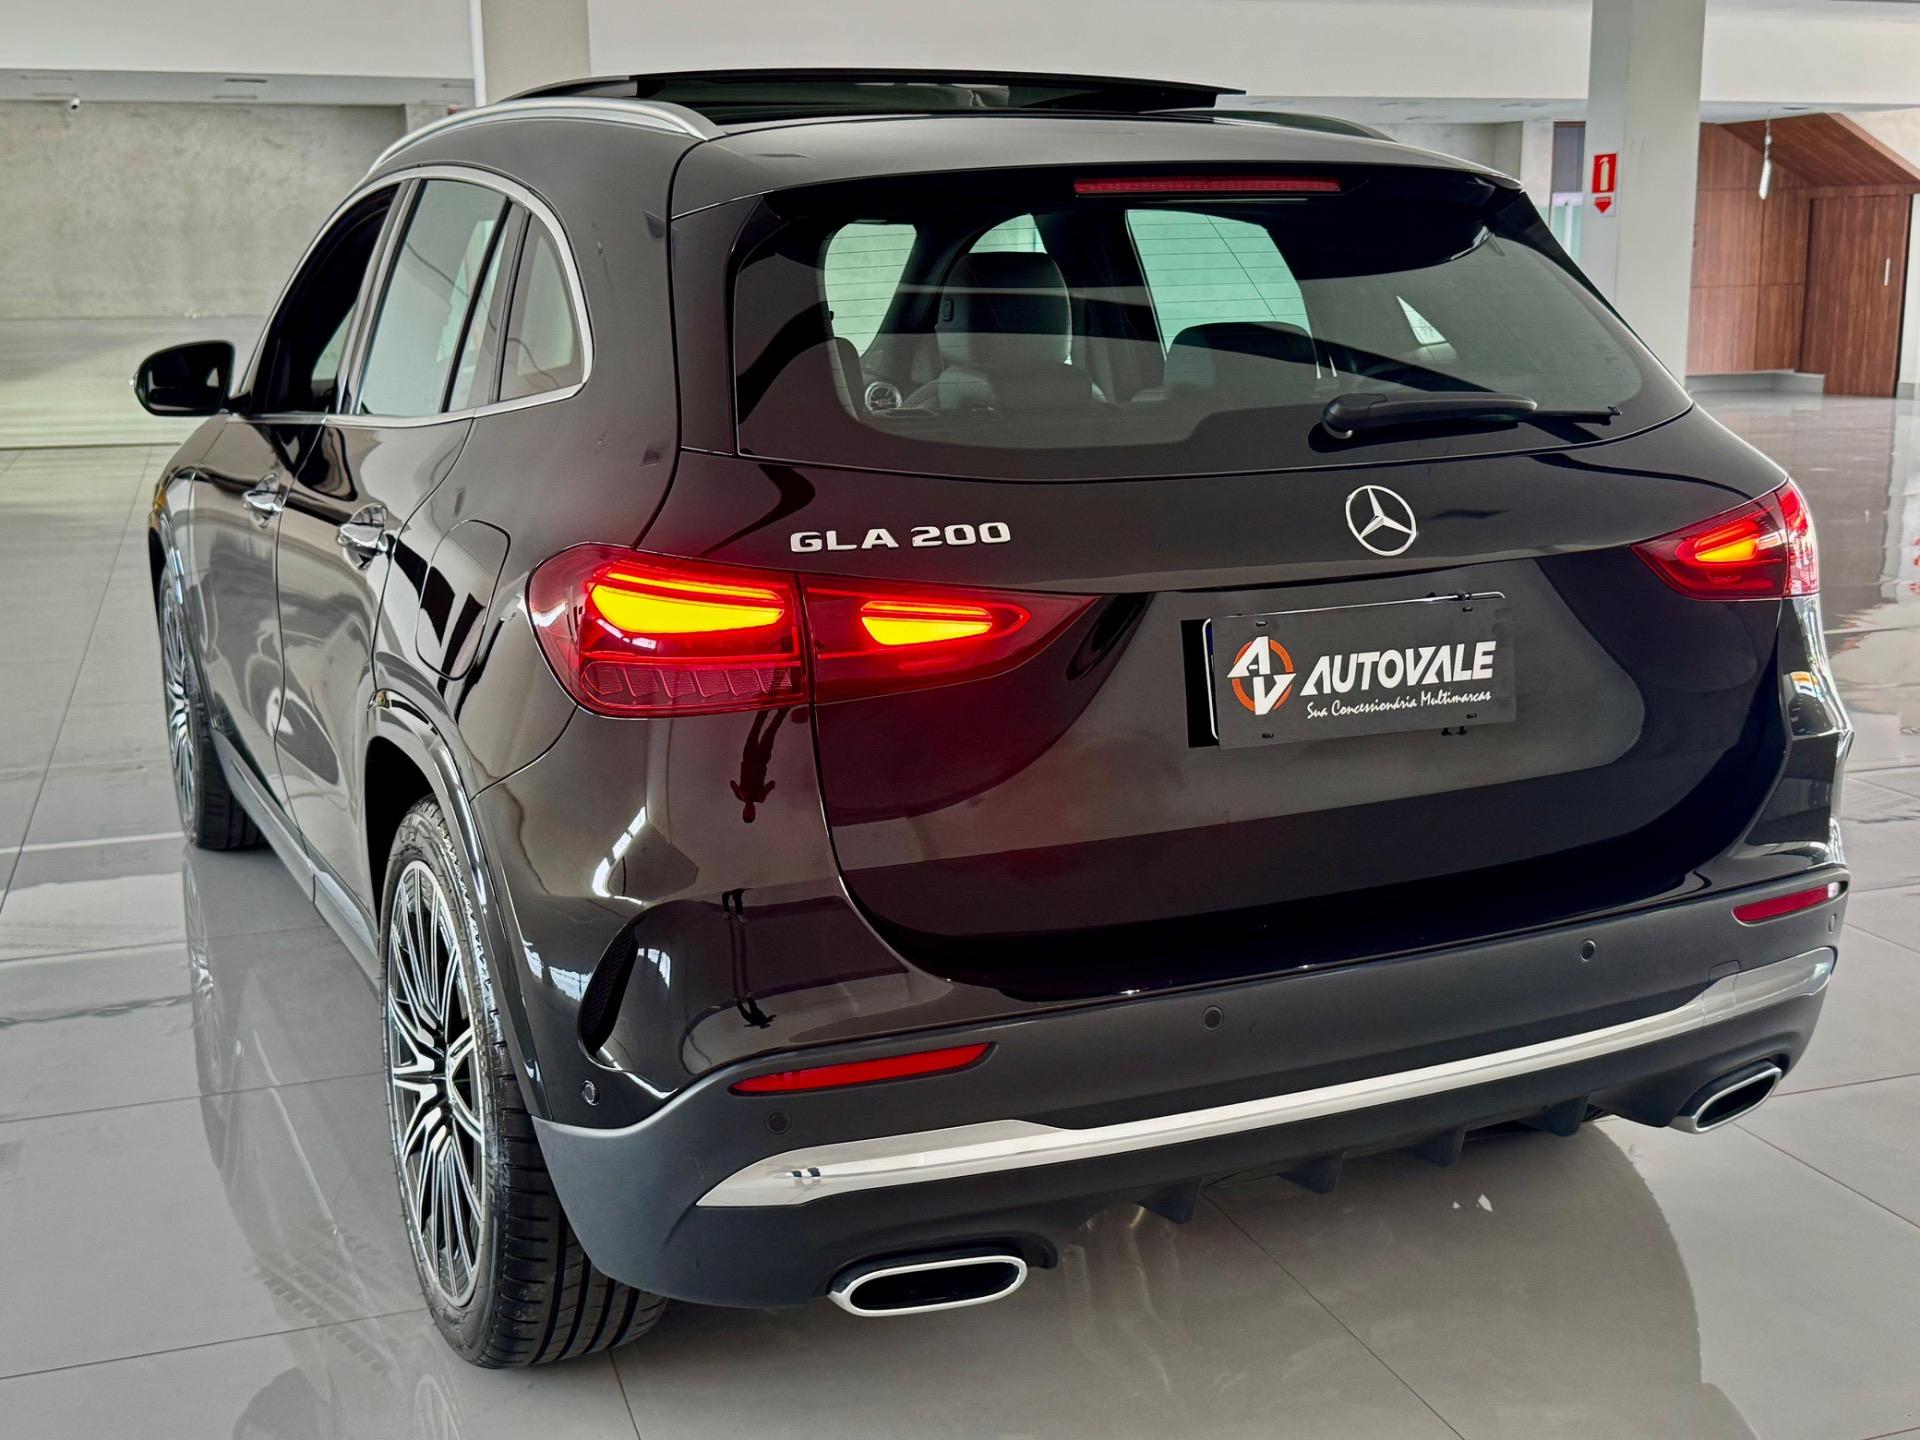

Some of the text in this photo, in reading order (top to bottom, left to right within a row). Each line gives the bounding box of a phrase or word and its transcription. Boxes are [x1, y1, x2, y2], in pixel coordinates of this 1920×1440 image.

[790, 522, 1011, 552] GLA 200
[1300, 641, 1496, 696] AUTOVALE
[1307, 689, 1491, 719] Sua Concessionária Multimarcas
